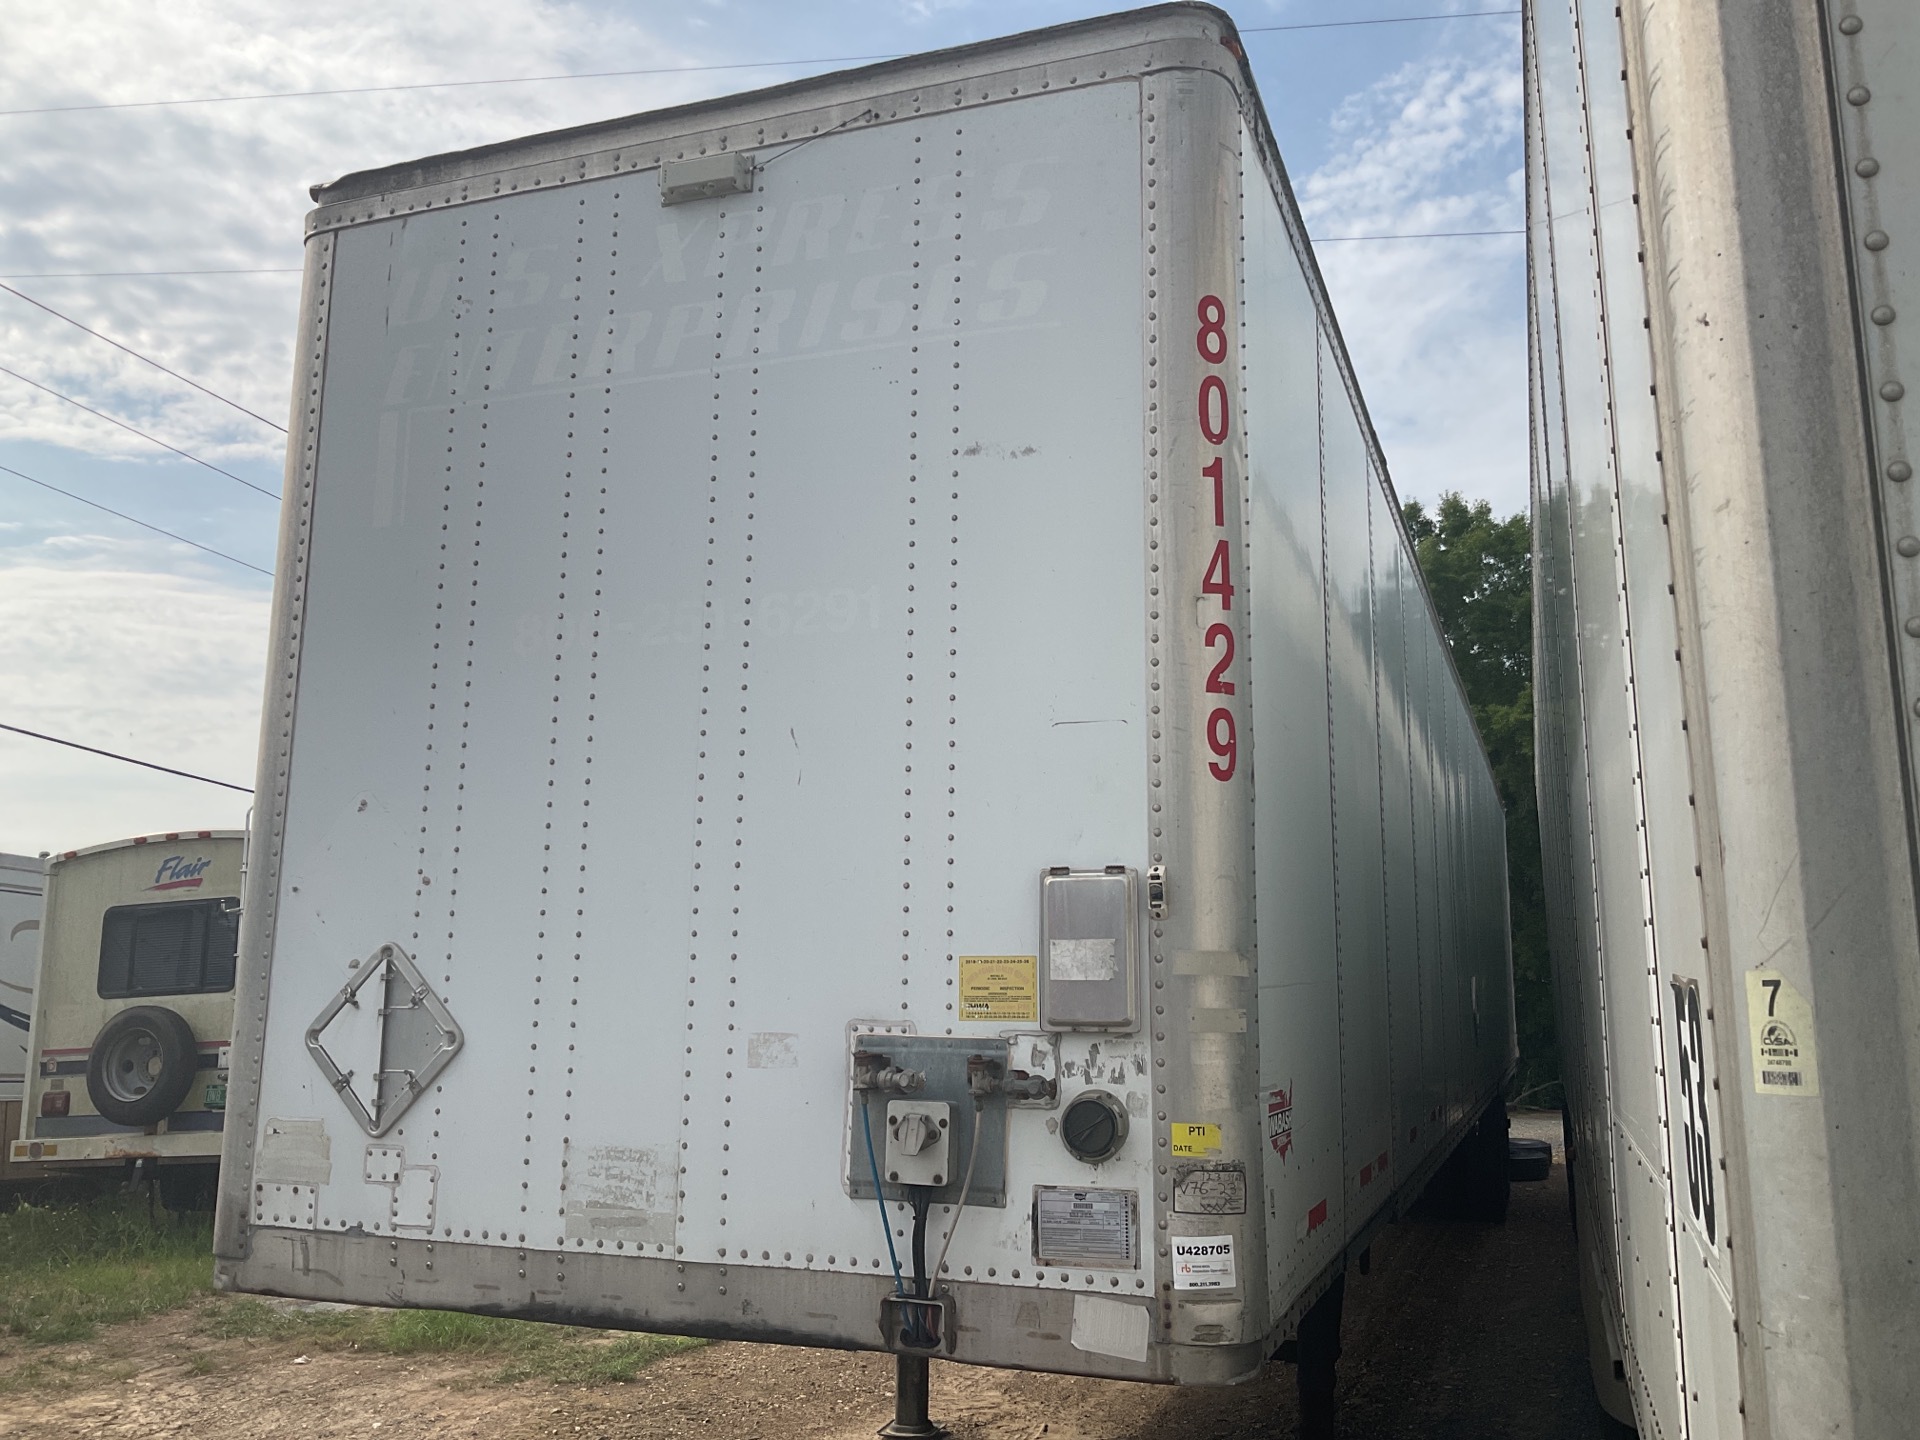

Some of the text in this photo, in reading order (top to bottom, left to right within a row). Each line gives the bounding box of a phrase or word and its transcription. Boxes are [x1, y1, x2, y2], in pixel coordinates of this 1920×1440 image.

[640, 156, 1060, 288] XPRESS
[383, 245, 1059, 407] ENTERPRISES
[1197, 294, 1238, 784] 801429
[154, 854, 211, 884] Flair
[1761, 979, 1782, 1017] 7
[1763, 1037, 1791, 1046] CVSA
[1188, 1126, 1206, 1137] PTI
[1173, 1144, 1193, 1153] DATE
[1176, 1244, 1230, 1256] U428705
[1181, 1263, 1191, 1273] rb
